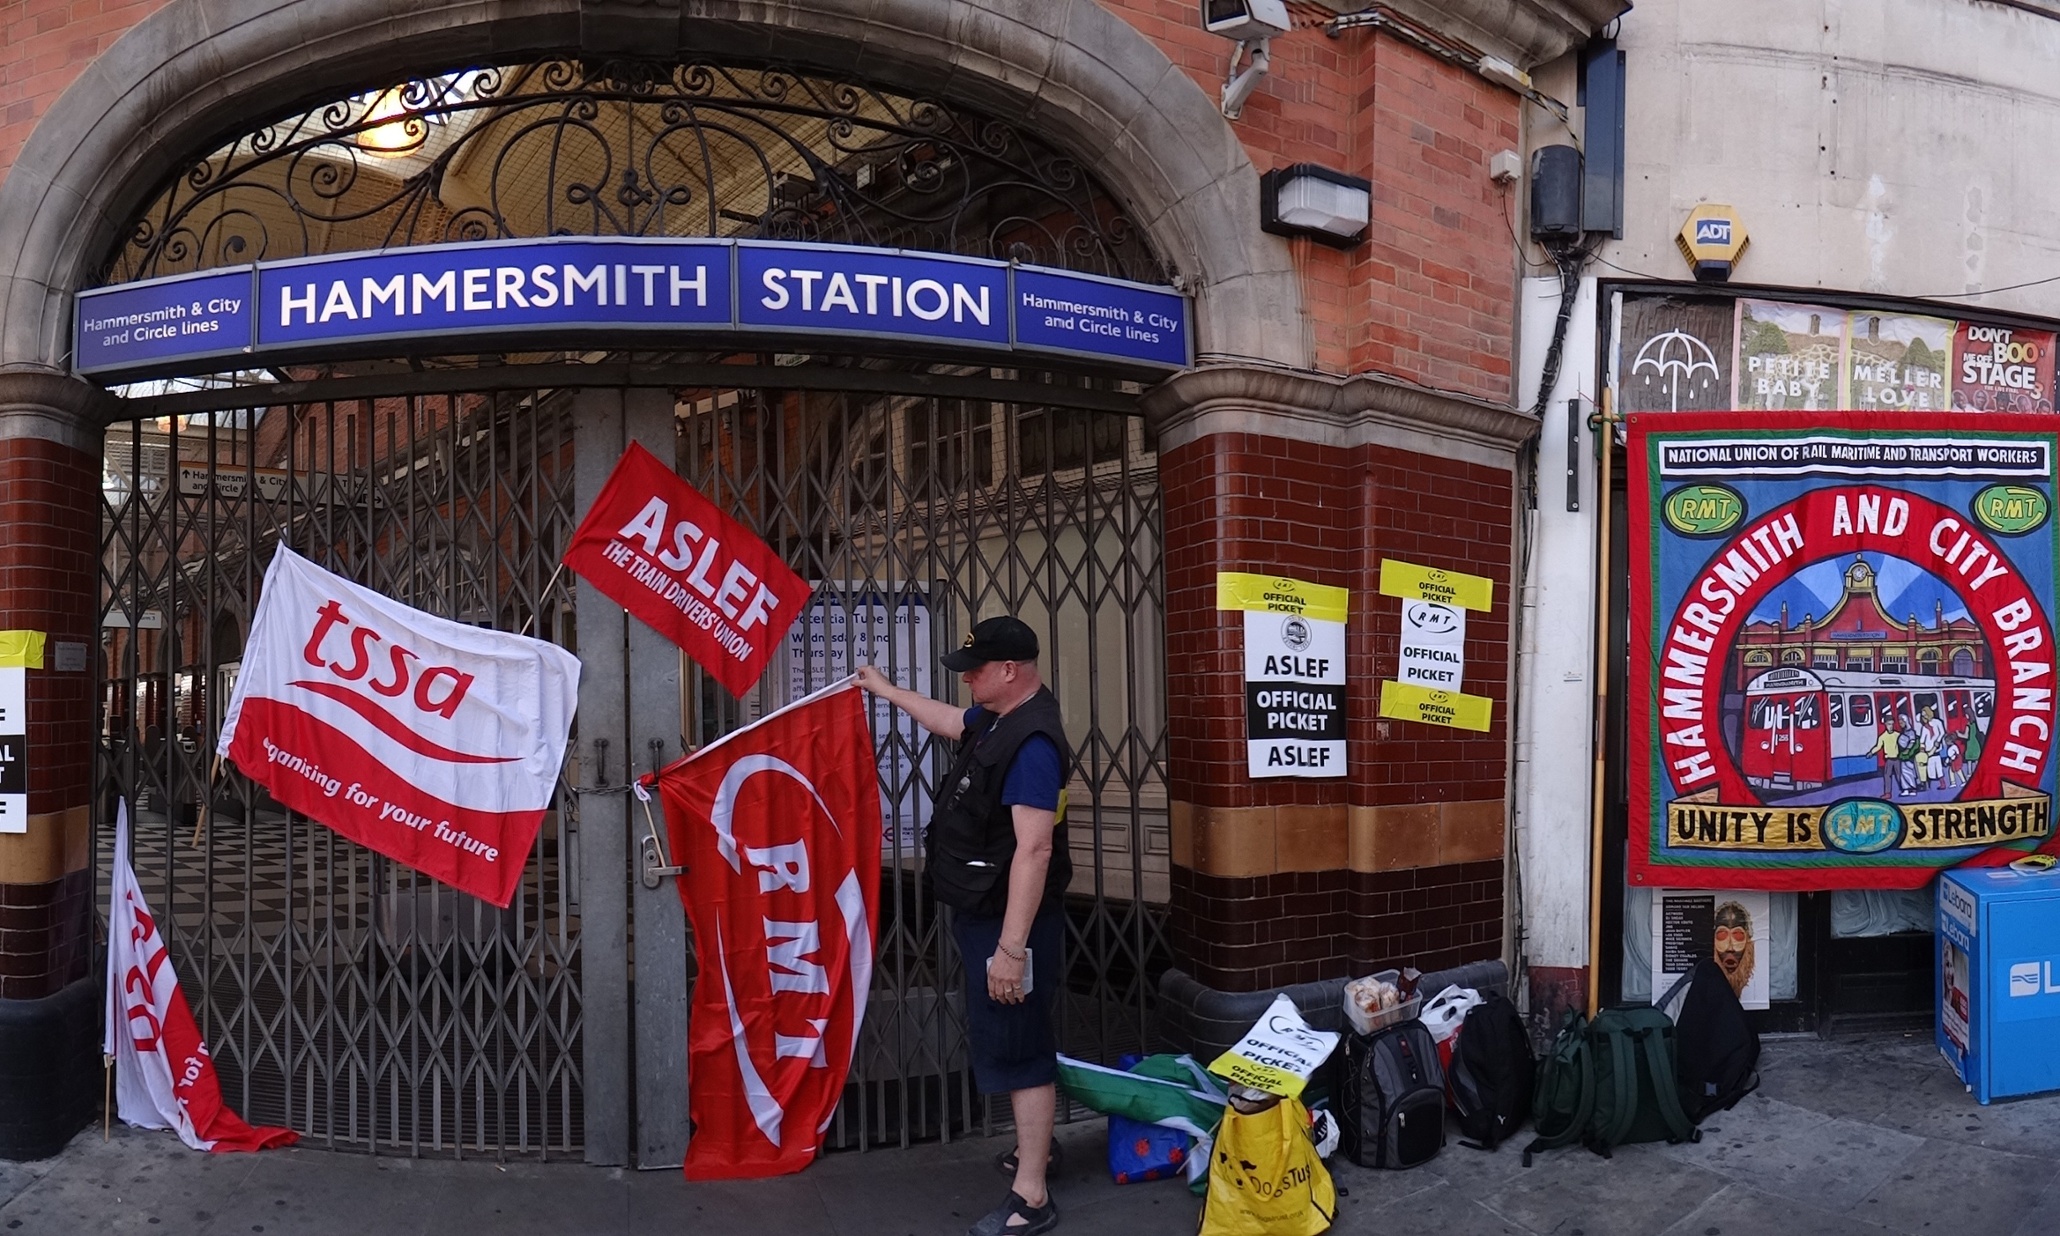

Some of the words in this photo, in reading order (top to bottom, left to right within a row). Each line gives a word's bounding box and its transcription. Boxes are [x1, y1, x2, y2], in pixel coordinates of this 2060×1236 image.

[1697, 224, 1730, 240] ADT
[280, 264, 707, 326] HAMMERSMITH
[760, 268, 990, 326] STATION
[84, 305, 186, 333] Hammersmith
[191, 302, 203, 316] &
[207, 298, 241, 314] City
[1022, 292, 1129, 322] Hammersmith
[1133, 310, 1144, 324] &
[1148, 313, 1178, 333] City
[103, 331, 129, 347] and
[134, 325, 177, 342] Circle
[182, 318, 219, 336] lines
[1045, 315, 1074, 330] and
[1079, 319, 1121, 337] Circle
[1126, 326, 1159, 343] lines
[1967, 326, 2013, 345] DON'T
[1993, 342, 2039, 364] BOO
[1748, 356, 1830, 380] PETITE
[1853, 365, 1942, 389] MELLER
[1962, 361, 2036, 390] STAGE
[2030, 382, 2044, 400] 3
[1867, 386, 1930, 408] LOVE
[1669, 448, 1732, 463] NATIONAL
[1734, 446, 1778, 462] UNION
[1781, 446, 1799, 461] OF
[1802, 445, 1828, 460] RAIL
[1831, 446, 1881, 461] MARITIME
[1883, 448, 1907, 461] AND
[1909, 448, 1974, 462] TRANSPORT
[1977, 449, 2037, 464] WORKERS
[260, 476, 266, 484] &
[1681, 497, 1733, 521] RMT
[1989, 496, 2037, 520] RMT
[618, 495, 780, 632] ASLEF
[1263, 592, 1307, 606] OFFICIAL
[1419, 582, 1457, 595] OFFICIAL
[1422, 592, 1452, 604] PICKET
[602, 539, 635, 568] THE
[627, 555, 672, 595] TRAIN
[663, 581, 720, 631] DRIVERS'
[713, 619, 754, 662] UNION
[1268, 603, 1304, 615] PICKET
[1418, 611, 1451, 625] RMT
[860, 632, 867, 643] 8
[1663, 512, 1805, 786] HAMMERSMITH
[1832, 494, 1909, 538] AND
[1929, 517, 2009, 592] CITY
[1992, 597, 2052, 775] BRANCH
[303, 600, 475, 720] tssa
[856, 648, 879, 659] Juy
[1403, 646, 1461, 664] OFFICIAL
[1263, 655, 1329, 678] ASLEF
[1407, 667, 1455, 683] PICKET
[1256, 690, 1337, 711] OFFICIAL
[1419, 703, 1456, 716] OFFICIAL
[1267, 712, 1328, 732] PICKET
[1421, 713, 1452, 725] PICKET
[1267, 745, 1330, 767] ASLEF
[345, 782, 379, 809] for
[379, 801, 432, 832] your
[434, 820, 499, 862] future
[1677, 809, 1773, 844] UNITY
[1787, 812, 1812, 843] IS
[1911, 800, 2048, 842] STRENGTH
[1838, 813, 1891, 836] RMT
[1948, 885, 1972, 919] Lebara
[1946, 919, 1970, 952] Lebara
[741, 837, 830, 1069] RMT
[1242, 1051, 1302, 1073] PICKET
[1246, 1039, 1314, 1068] OFFICIAL
[1230, 1072, 1275, 1090] PICKET
[1232, 1065, 1282, 1086] OFFICIAL
